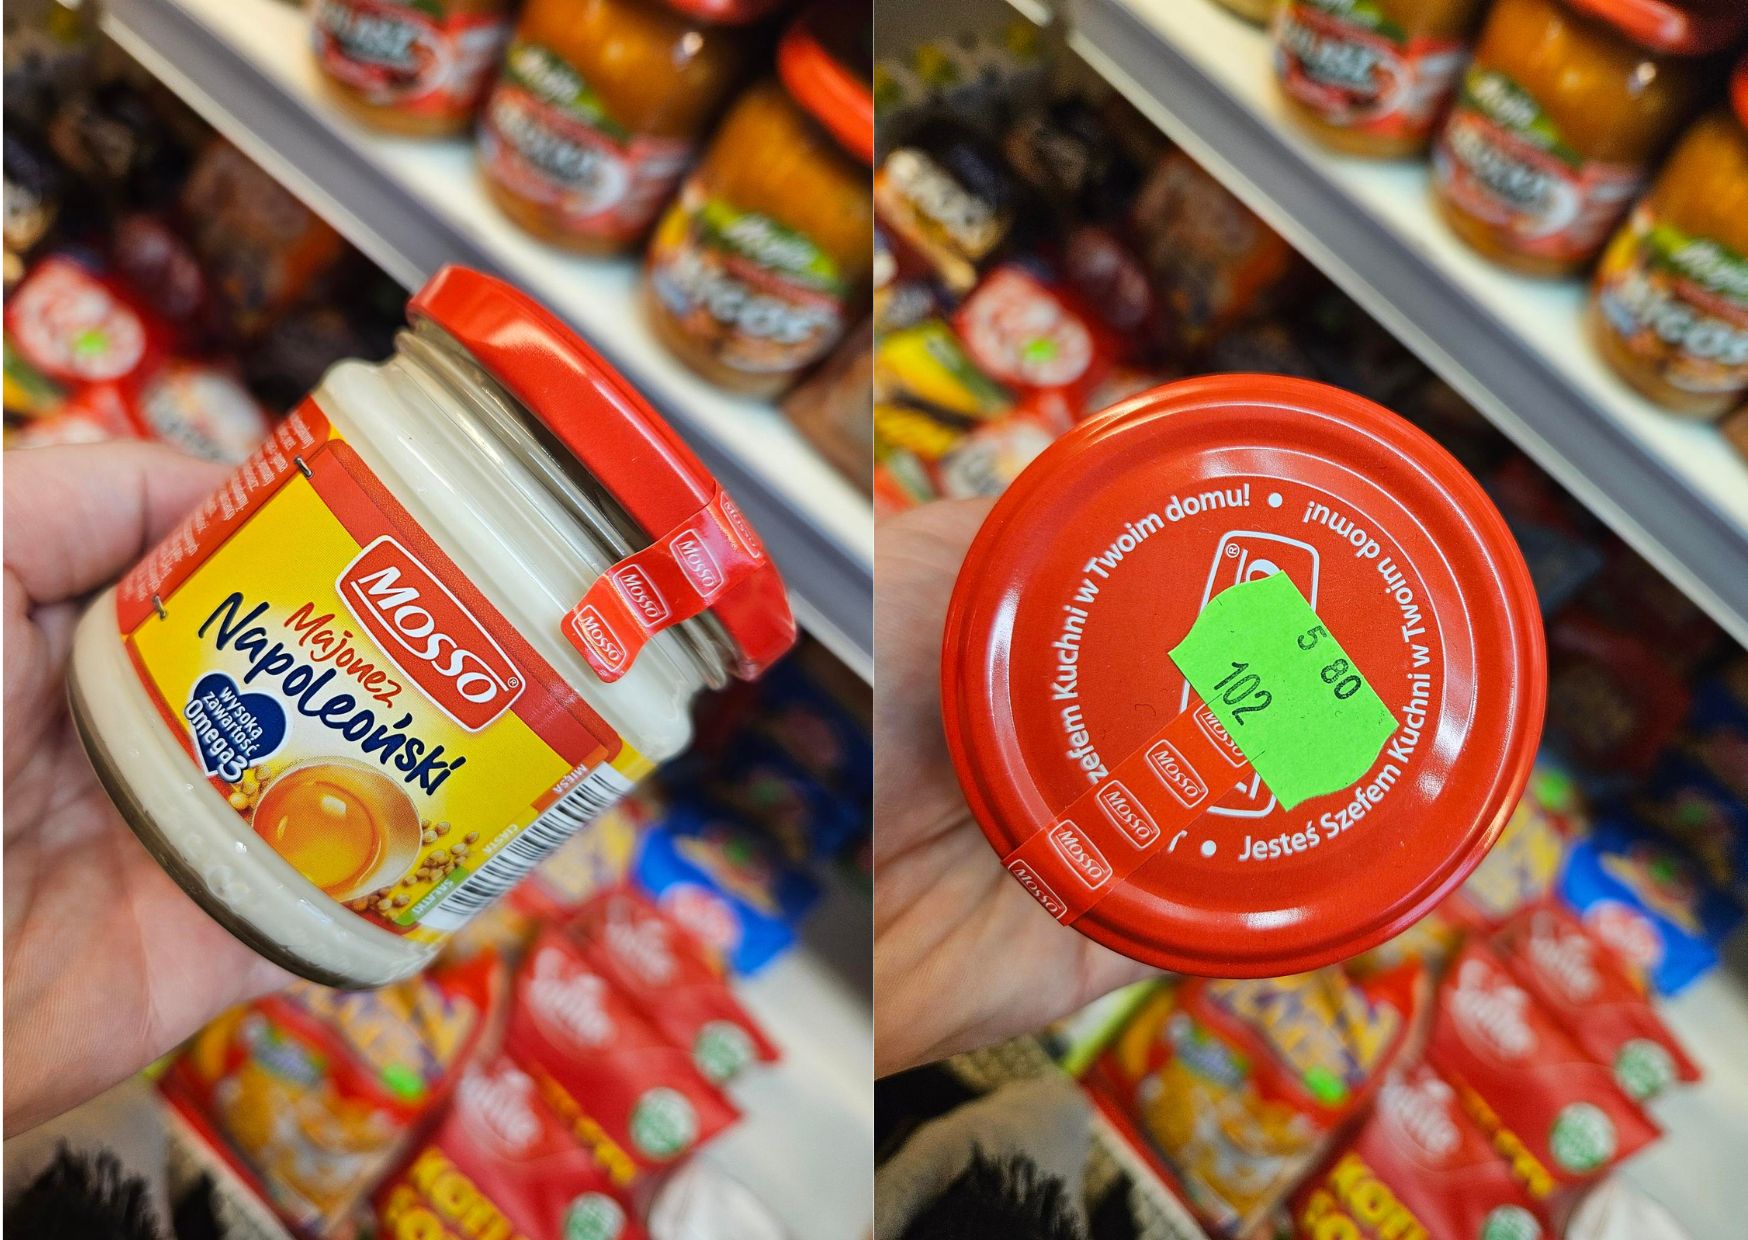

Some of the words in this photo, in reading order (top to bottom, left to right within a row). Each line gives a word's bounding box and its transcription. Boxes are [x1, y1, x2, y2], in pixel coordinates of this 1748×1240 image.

[1165, 483, 1250, 522] domu!
[1303, 500, 1382, 559] domu!
[677, 540, 716, 588] MOSSO
[1084, 512, 1165, 579] Twoim
[619, 573, 660, 618] MOSSO
[1074, 579, 1100, 604] w
[1377, 556, 1427, 643] Twoim
[283, 602, 402, 709] Majonez
[353, 566, 505, 703] MOSSO
[578, 616, 621, 661] MOSSO
[1051, 604, 1089, 701] Kuchni
[1297, 624, 1328, 651] 5
[1320, 658, 1363, 700] 80
[1412, 648, 1431, 670] w
[197, 592, 466, 796] Napoleoński
[220, 686, 263, 739] wysoka
[1214, 661, 1272, 726] 102
[1388, 673, 1431, 764] Kuchni
[203, 691, 260, 756] zawartość
[1060, 704, 1109, 784] zefem
[553, 763, 588, 795] MIĘSA
[1152, 750, 1201, 798] MOSSO
[1320, 761, 1402, 835] Szefem
[1104, 790, 1153, 839] MOSSO
[1238, 820, 1320, 862] Jesteś
[1055, 830, 1105, 879] MOSSO
[1013, 867, 1061, 913] MOSSO
